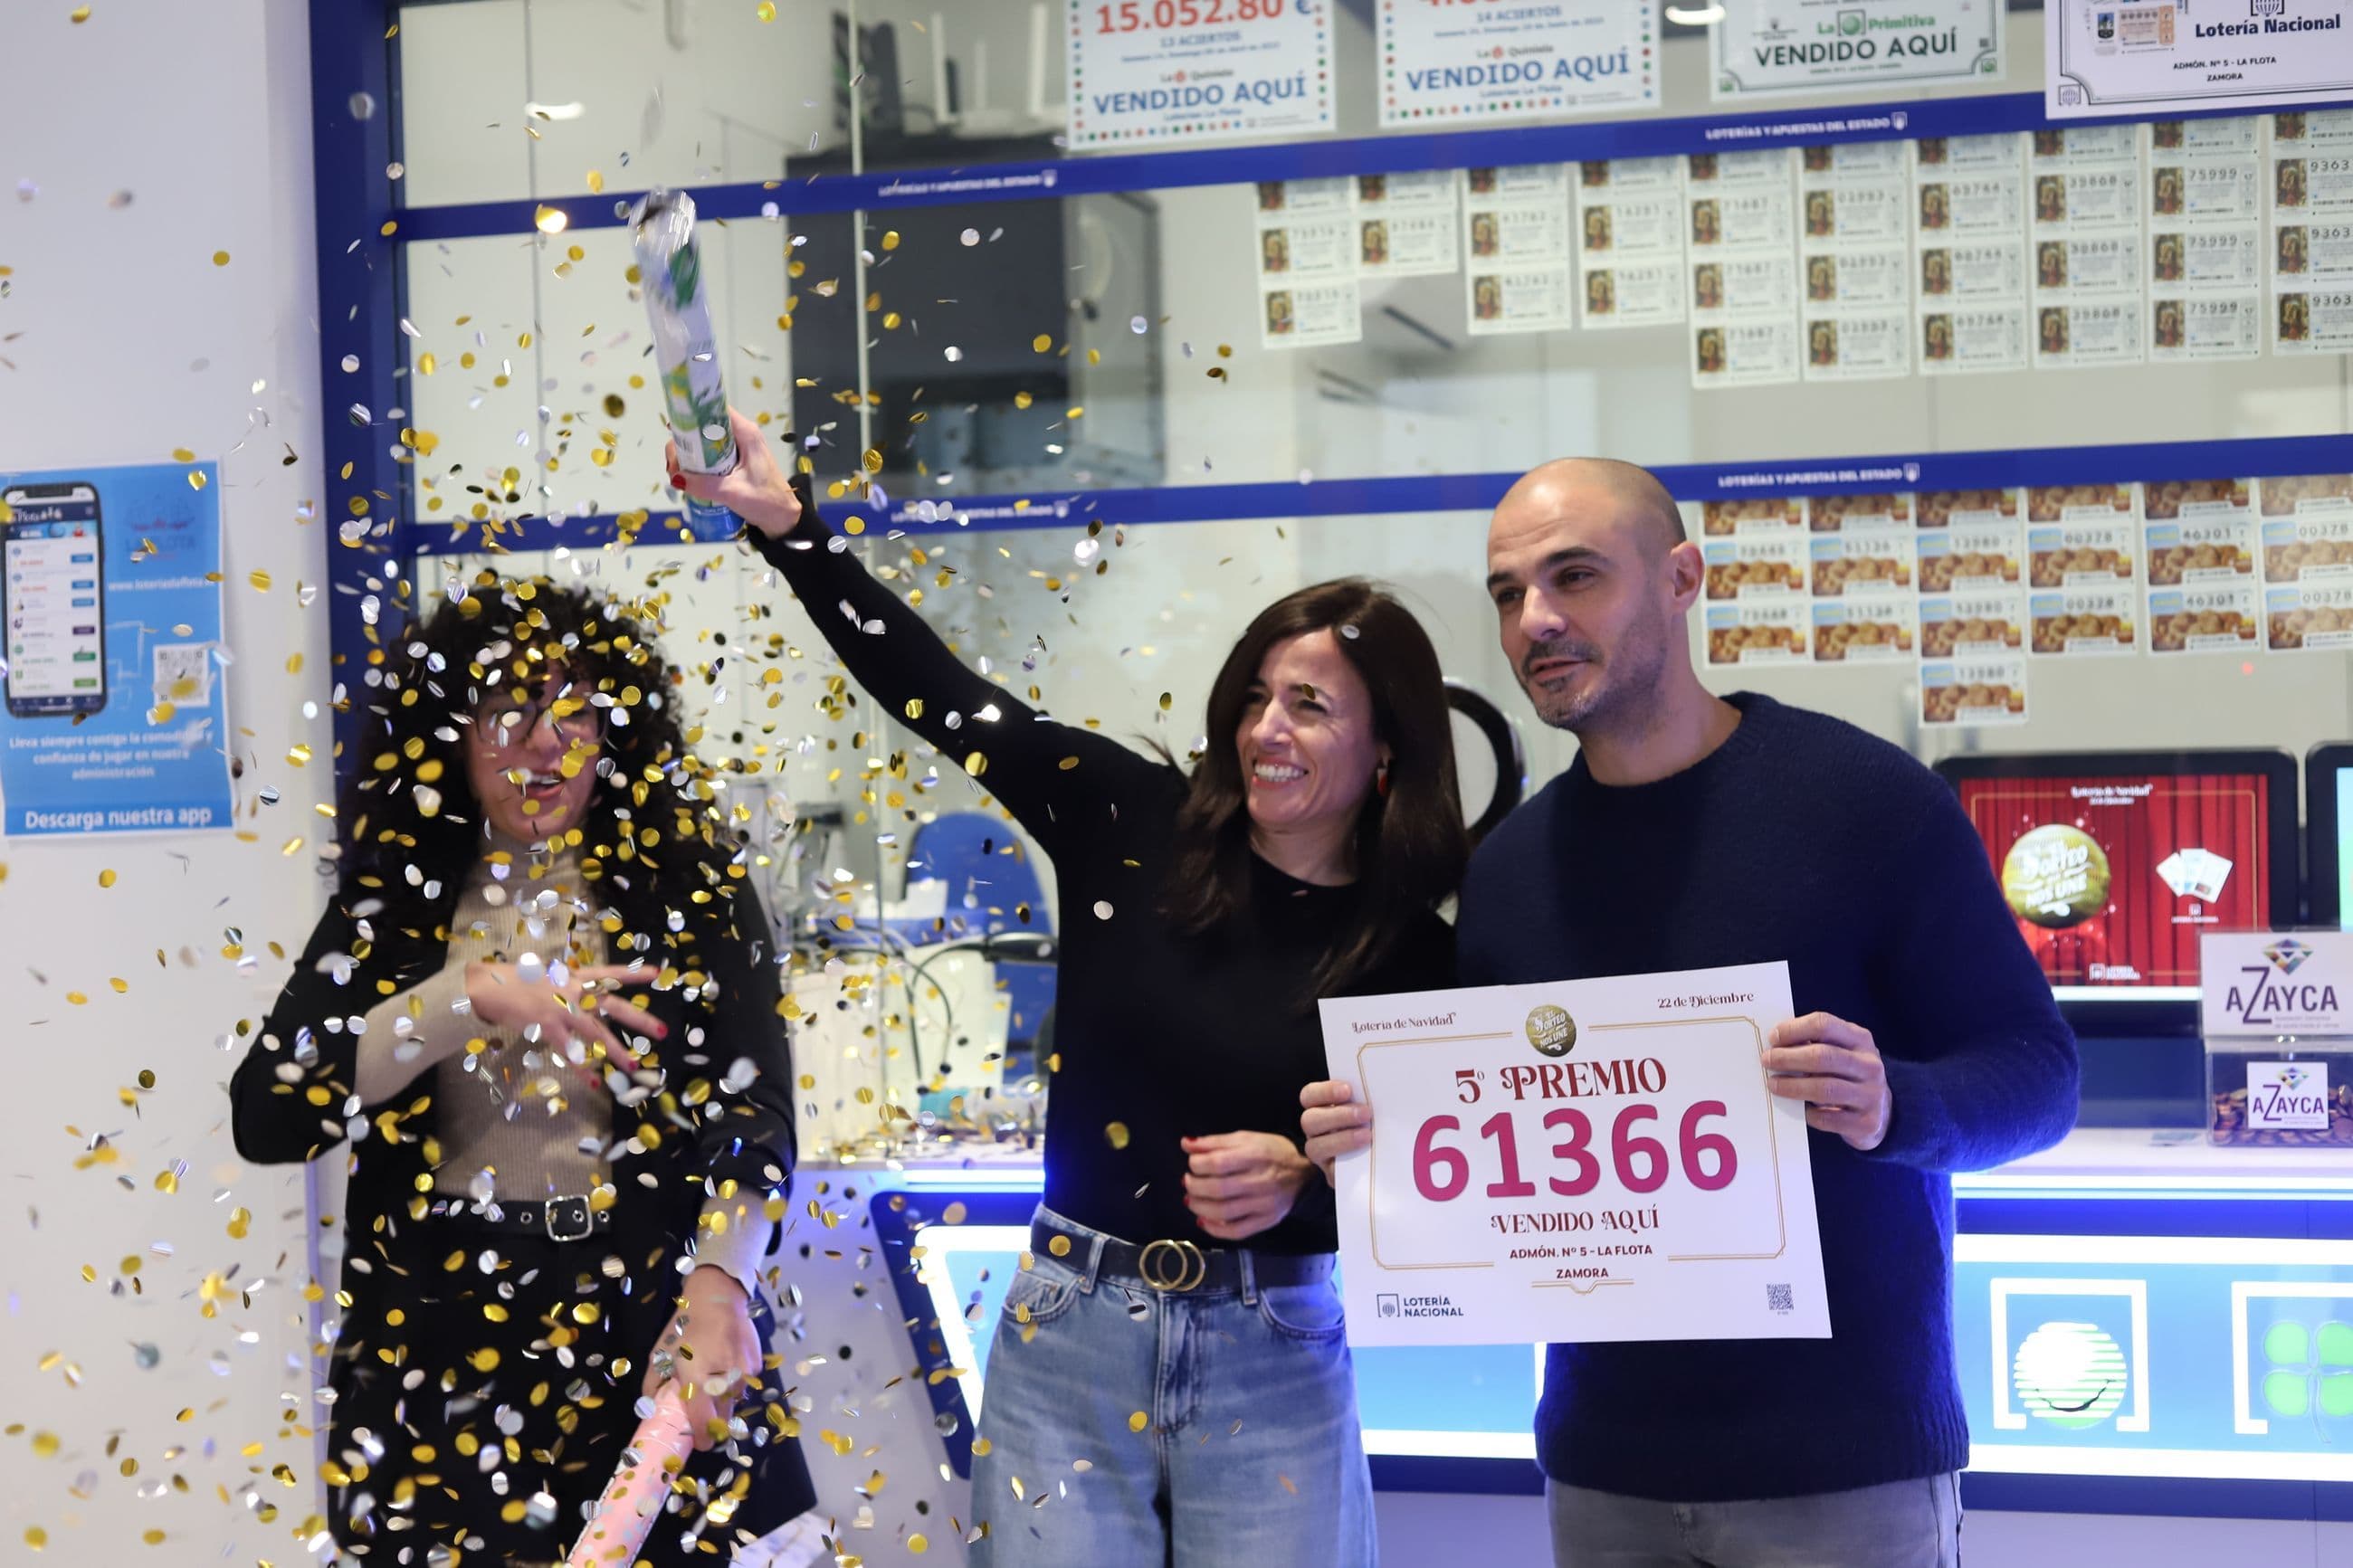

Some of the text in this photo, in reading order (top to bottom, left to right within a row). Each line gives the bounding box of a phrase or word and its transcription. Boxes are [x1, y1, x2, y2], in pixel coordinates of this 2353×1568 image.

[1817, 15, 1936, 34] La Primitiva
[2196, 14, 2341, 37] Lotería Nacional
[1754, 26, 1958, 67] VENDIDO AQUÍ
[1407, 45, 1630, 90] VENDIDO AQUÍ
[2173, 59, 2208, 71] ADMÓN.
[2236, 58, 2248, 66] LA
[2250, 56, 2277, 65] FLOTA
[2206, 71, 2243, 81] ZAMORA
[1094, 71, 1307, 114] VENDIDO AQUÍ
[1847, 117, 1891, 131] ESTADO
[1860, 468, 1903, 480] ESTADO
[142, 730, 203, 743] comodi
[25, 807, 212, 831] Descarga nuestra app
[1658, 993, 1754, 1008] 22 de Diciembre
[2225, 966, 2339, 1024] AZAYCA
[1394, 1019, 1407, 1028] de
[1408, 1012, 1456, 1028] Navidad
[1454, 1057, 1667, 1104] 5º PREMIO
[2253, 1085, 2325, 1121] AZAYCA
[1412, 1099, 1739, 1202] 61366
[1491, 1203, 1660, 1234] VENDIDO AQUÍ
[1510, 1244, 1559, 1259] ADMÓN.
[1579, 1247, 1587, 1257] 5
[1597, 1246, 1613, 1257] LA
[1615, 1245, 1653, 1256] FLOTA
[1556, 1268, 1609, 1279] ZAMORA
[1403, 1295, 1451, 1307] LOTERÍA
[1404, 1307, 1464, 1317] NACIONAL
